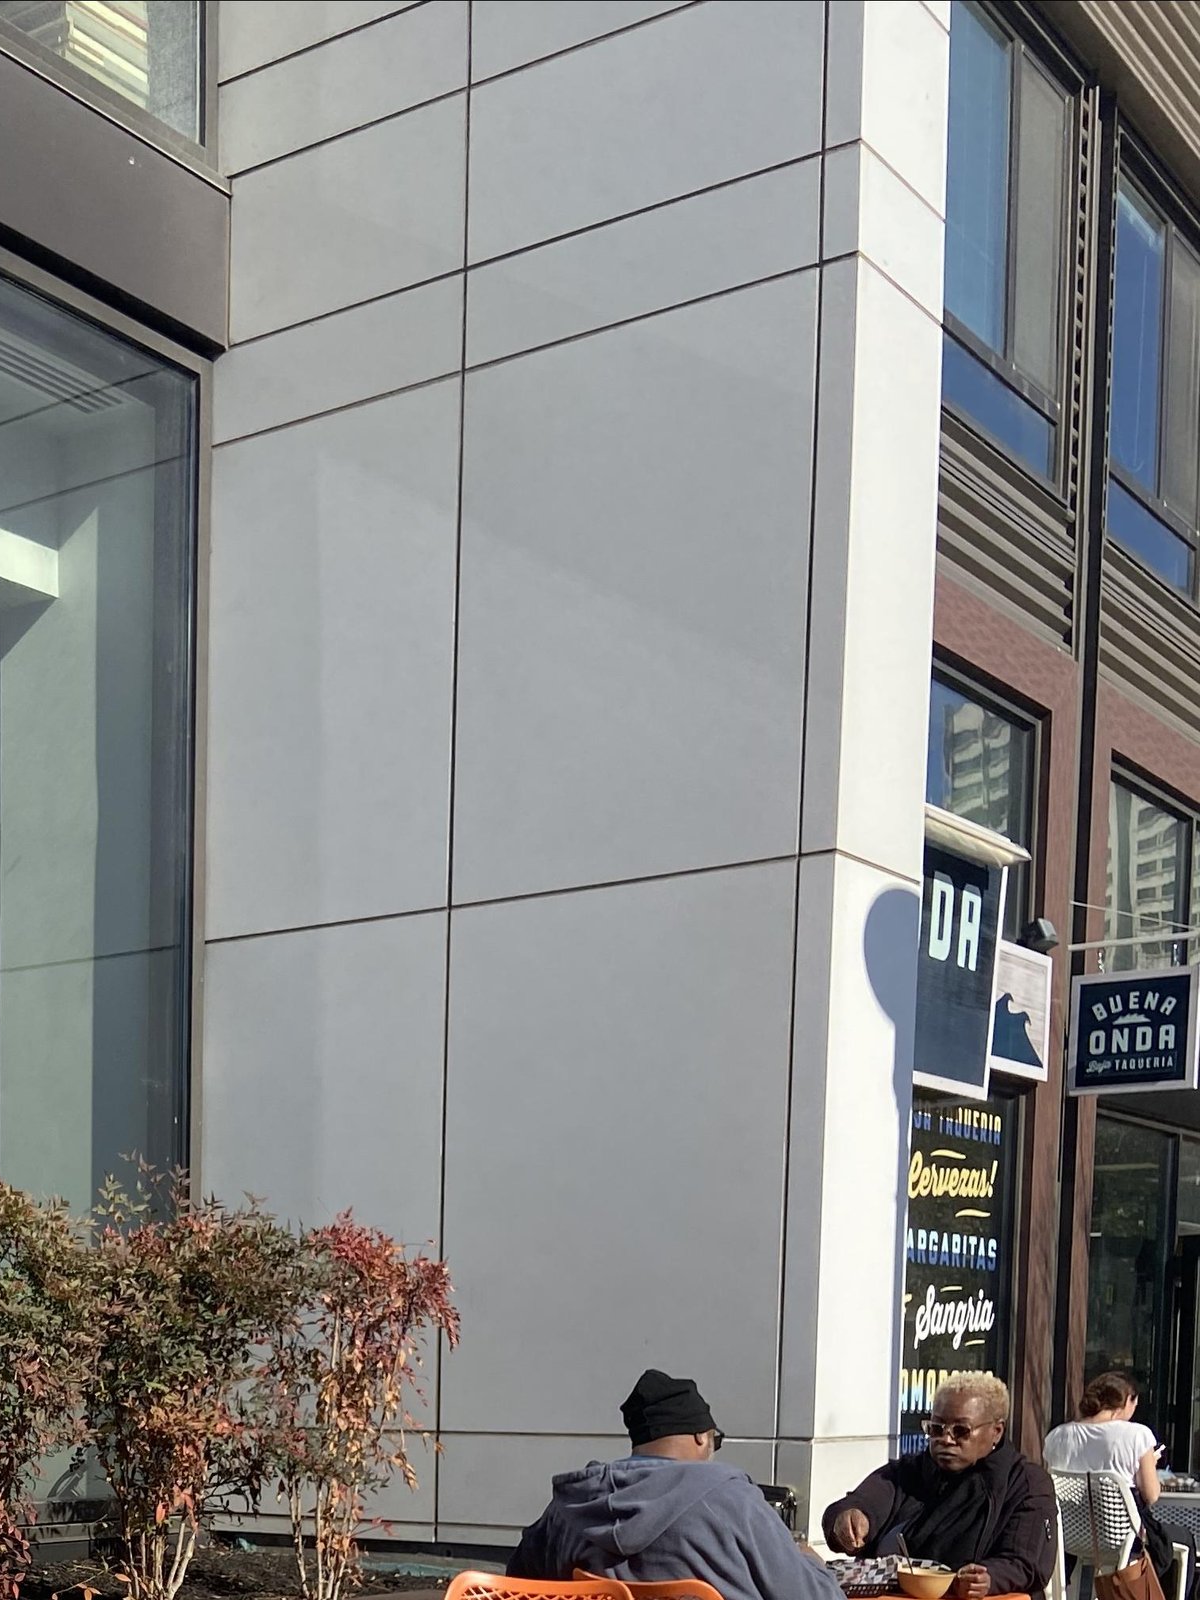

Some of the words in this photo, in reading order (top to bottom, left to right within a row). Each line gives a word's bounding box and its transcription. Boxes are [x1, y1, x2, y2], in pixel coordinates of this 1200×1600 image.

[928, 871, 983, 971] DA
[1091, 990, 1177, 1021] BUENA
[1089, 1023, 1176, 1056] ONDA
[1115, 1056, 1173, 1071] TAQUERIA
[907, 1150, 998, 1199] Cervezas!
[913, 1284, 995, 1350] Sangria
